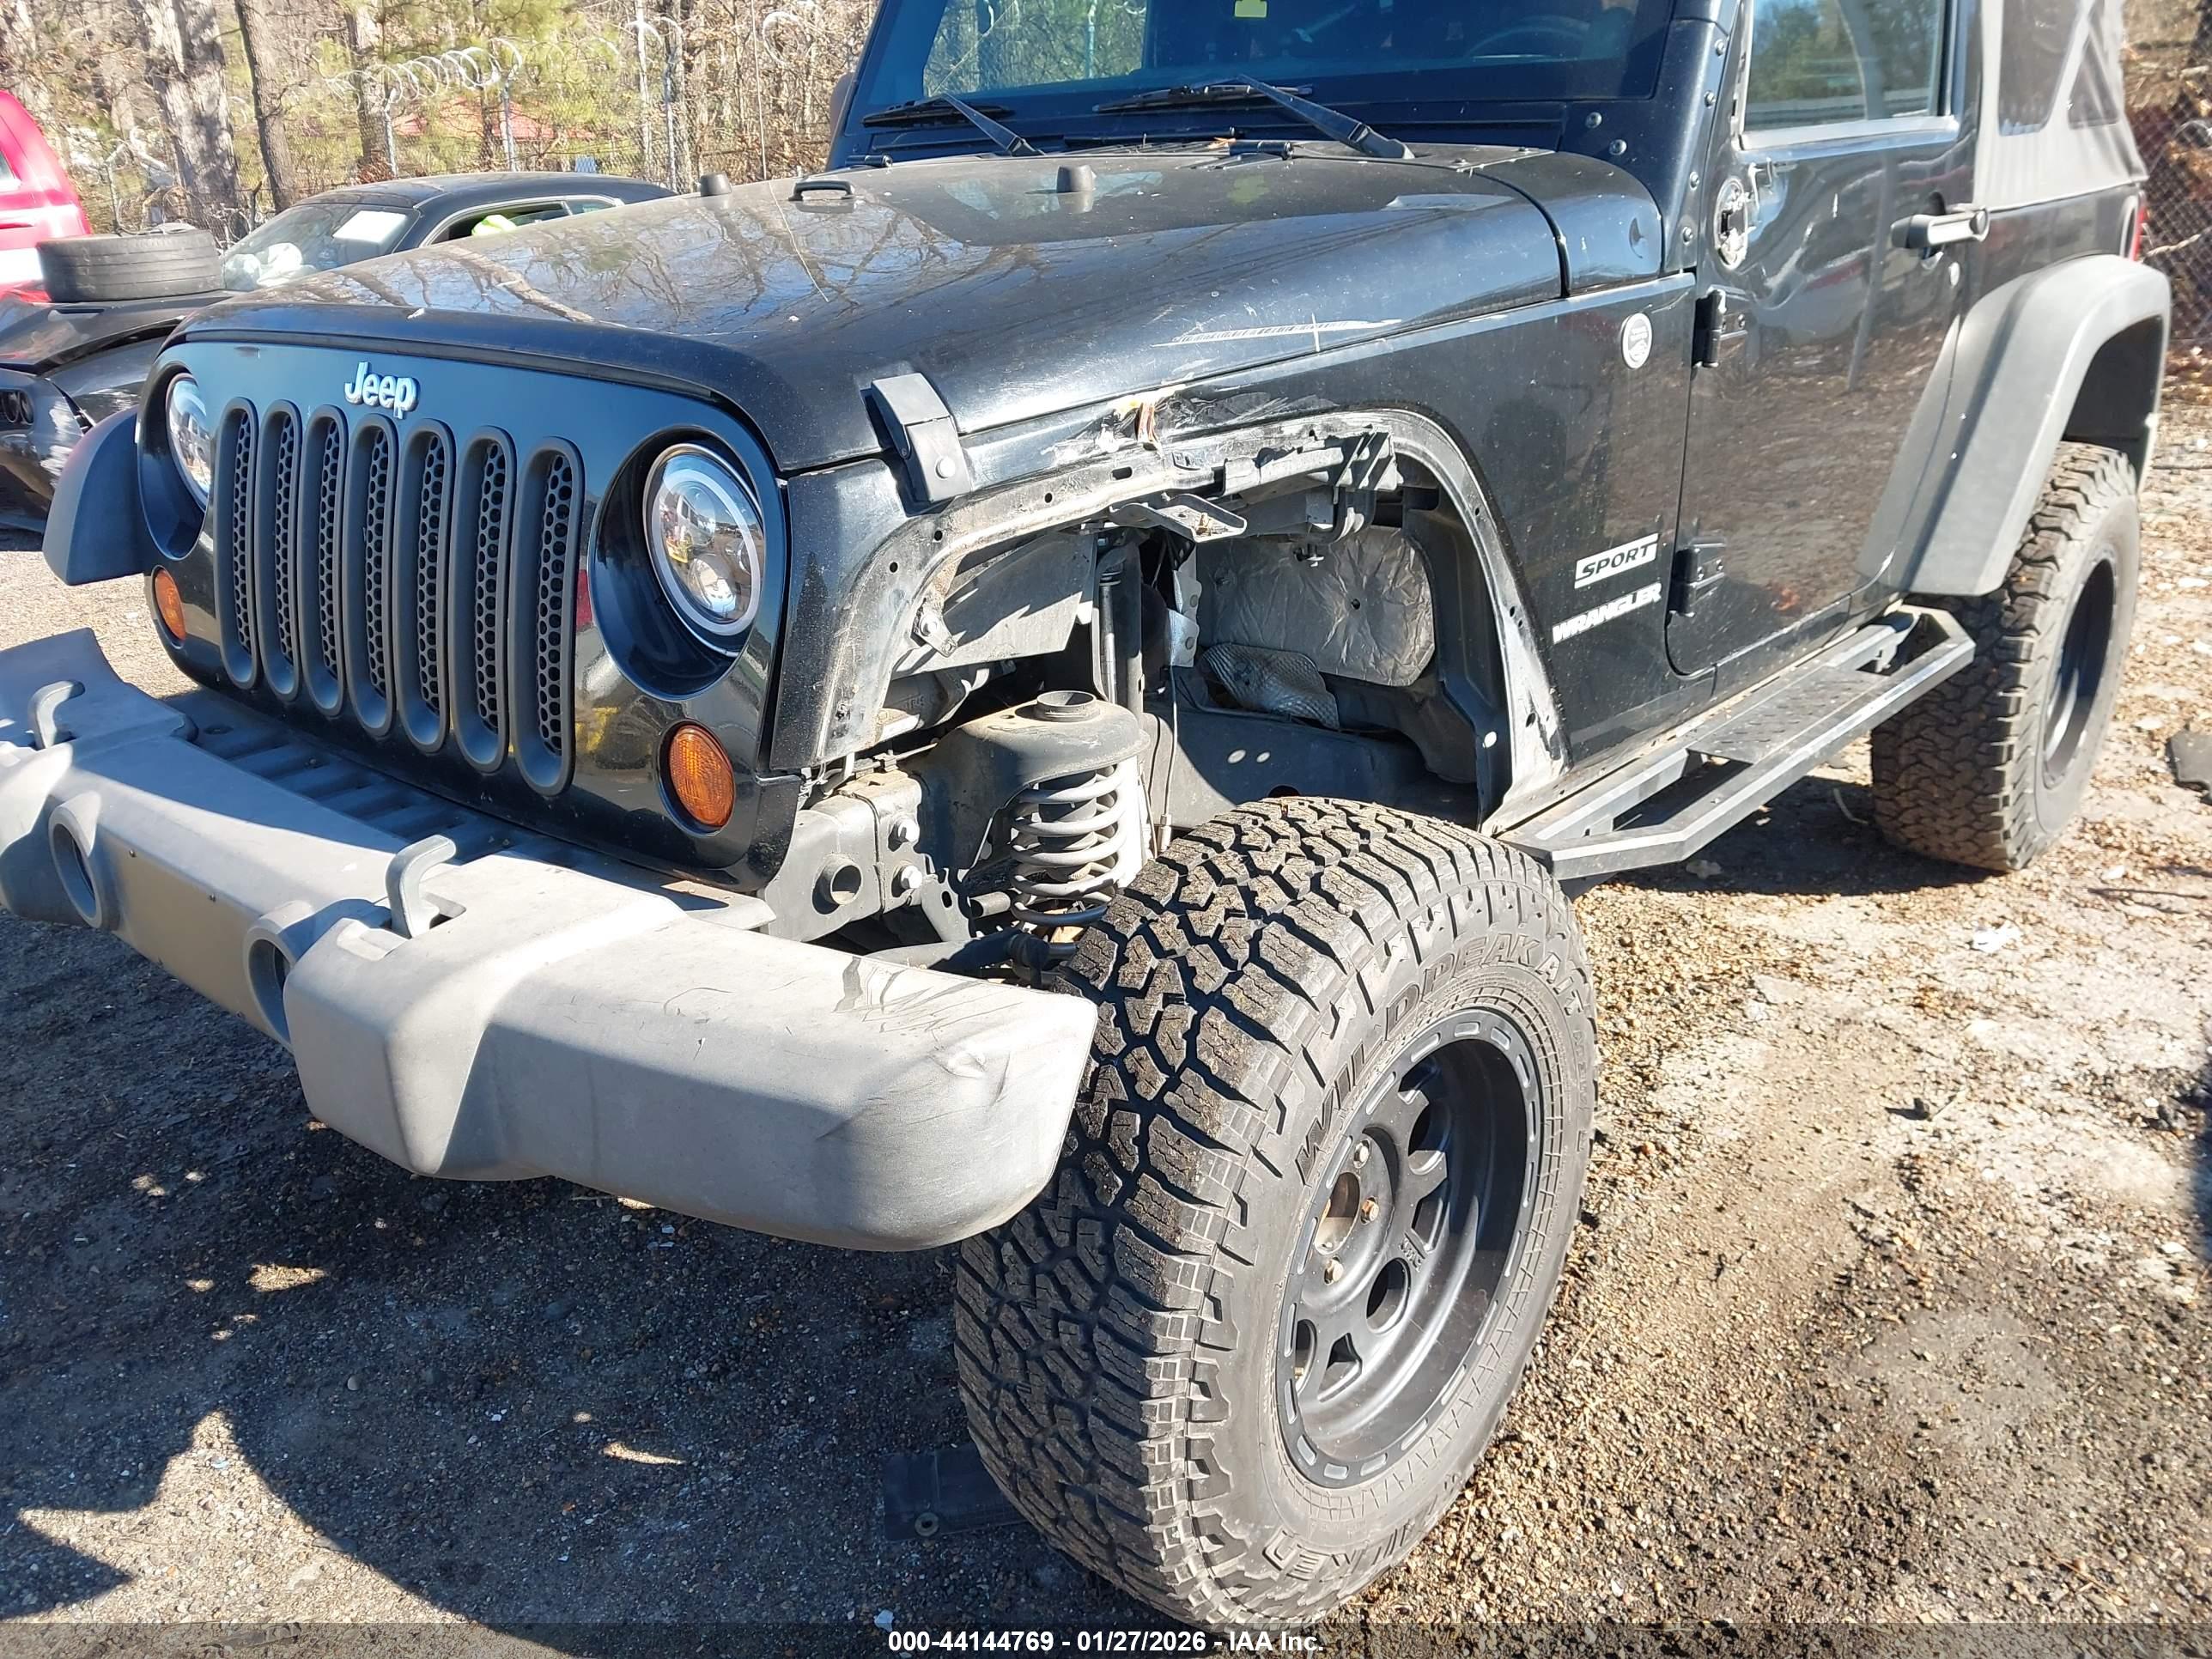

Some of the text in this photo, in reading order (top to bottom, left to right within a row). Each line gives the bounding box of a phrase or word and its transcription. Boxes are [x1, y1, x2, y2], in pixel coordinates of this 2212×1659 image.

[344, 361, 418, 420] Jeep
[1578, 541, 1654, 581] SPORT
[1552, 581, 1662, 644] WRANGLER
